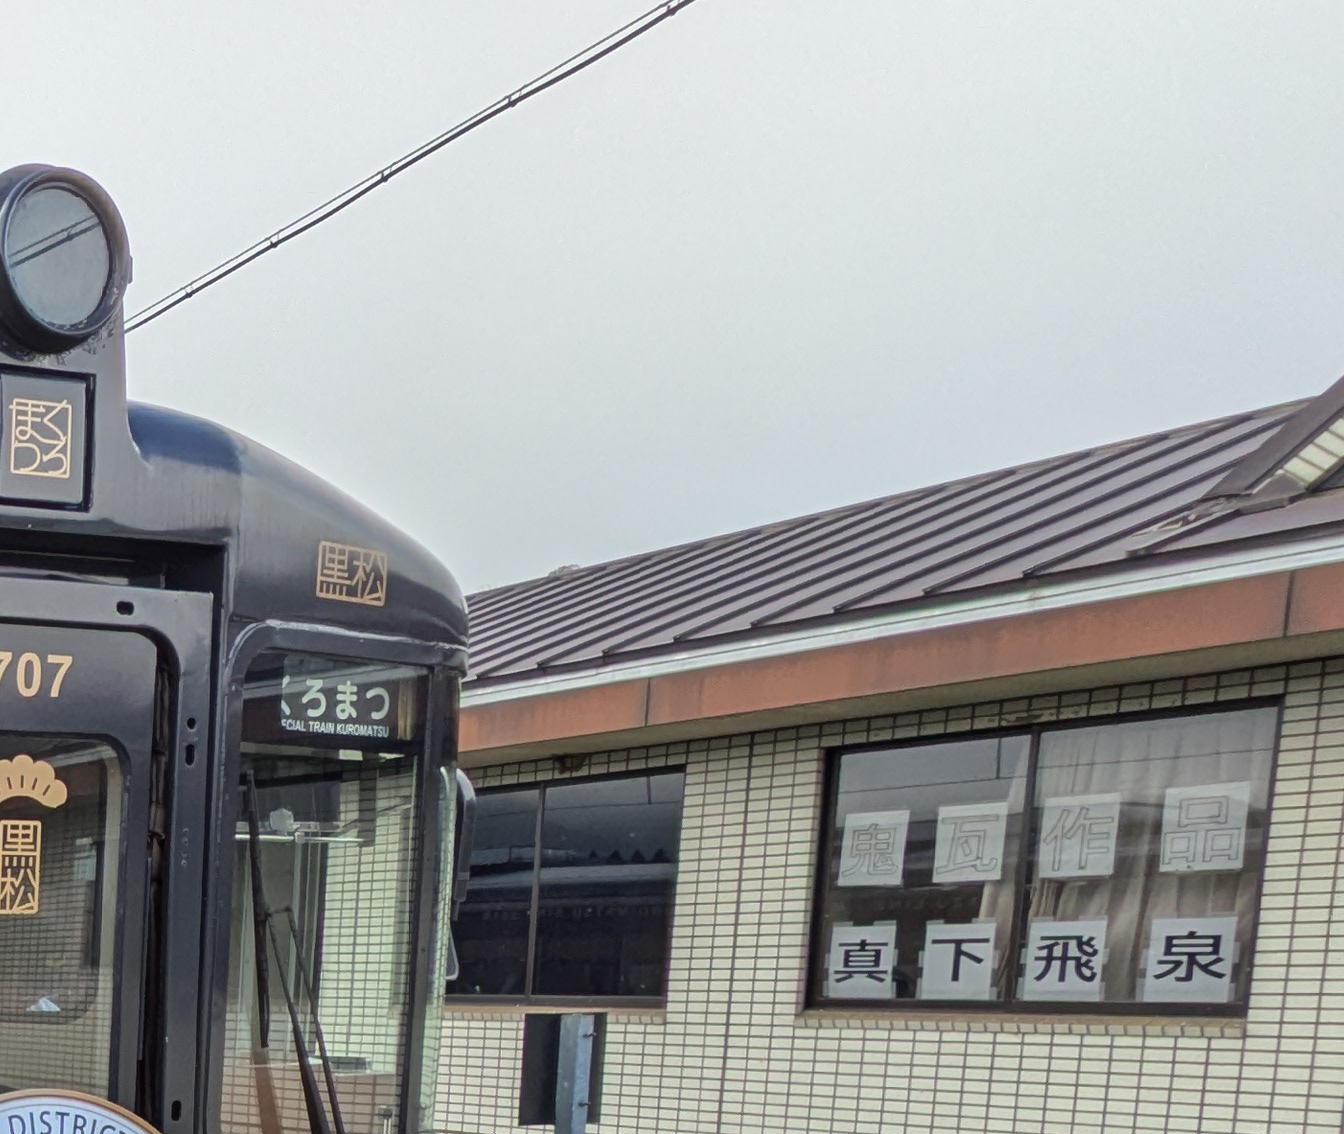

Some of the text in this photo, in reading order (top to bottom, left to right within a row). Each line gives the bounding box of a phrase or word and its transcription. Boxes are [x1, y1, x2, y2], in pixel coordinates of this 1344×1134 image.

[308, 721, 334, 734] TRAIN
[336, 723, 390, 738] KUROMATSU
[833, 930, 1227, 984] 真下飛泉
